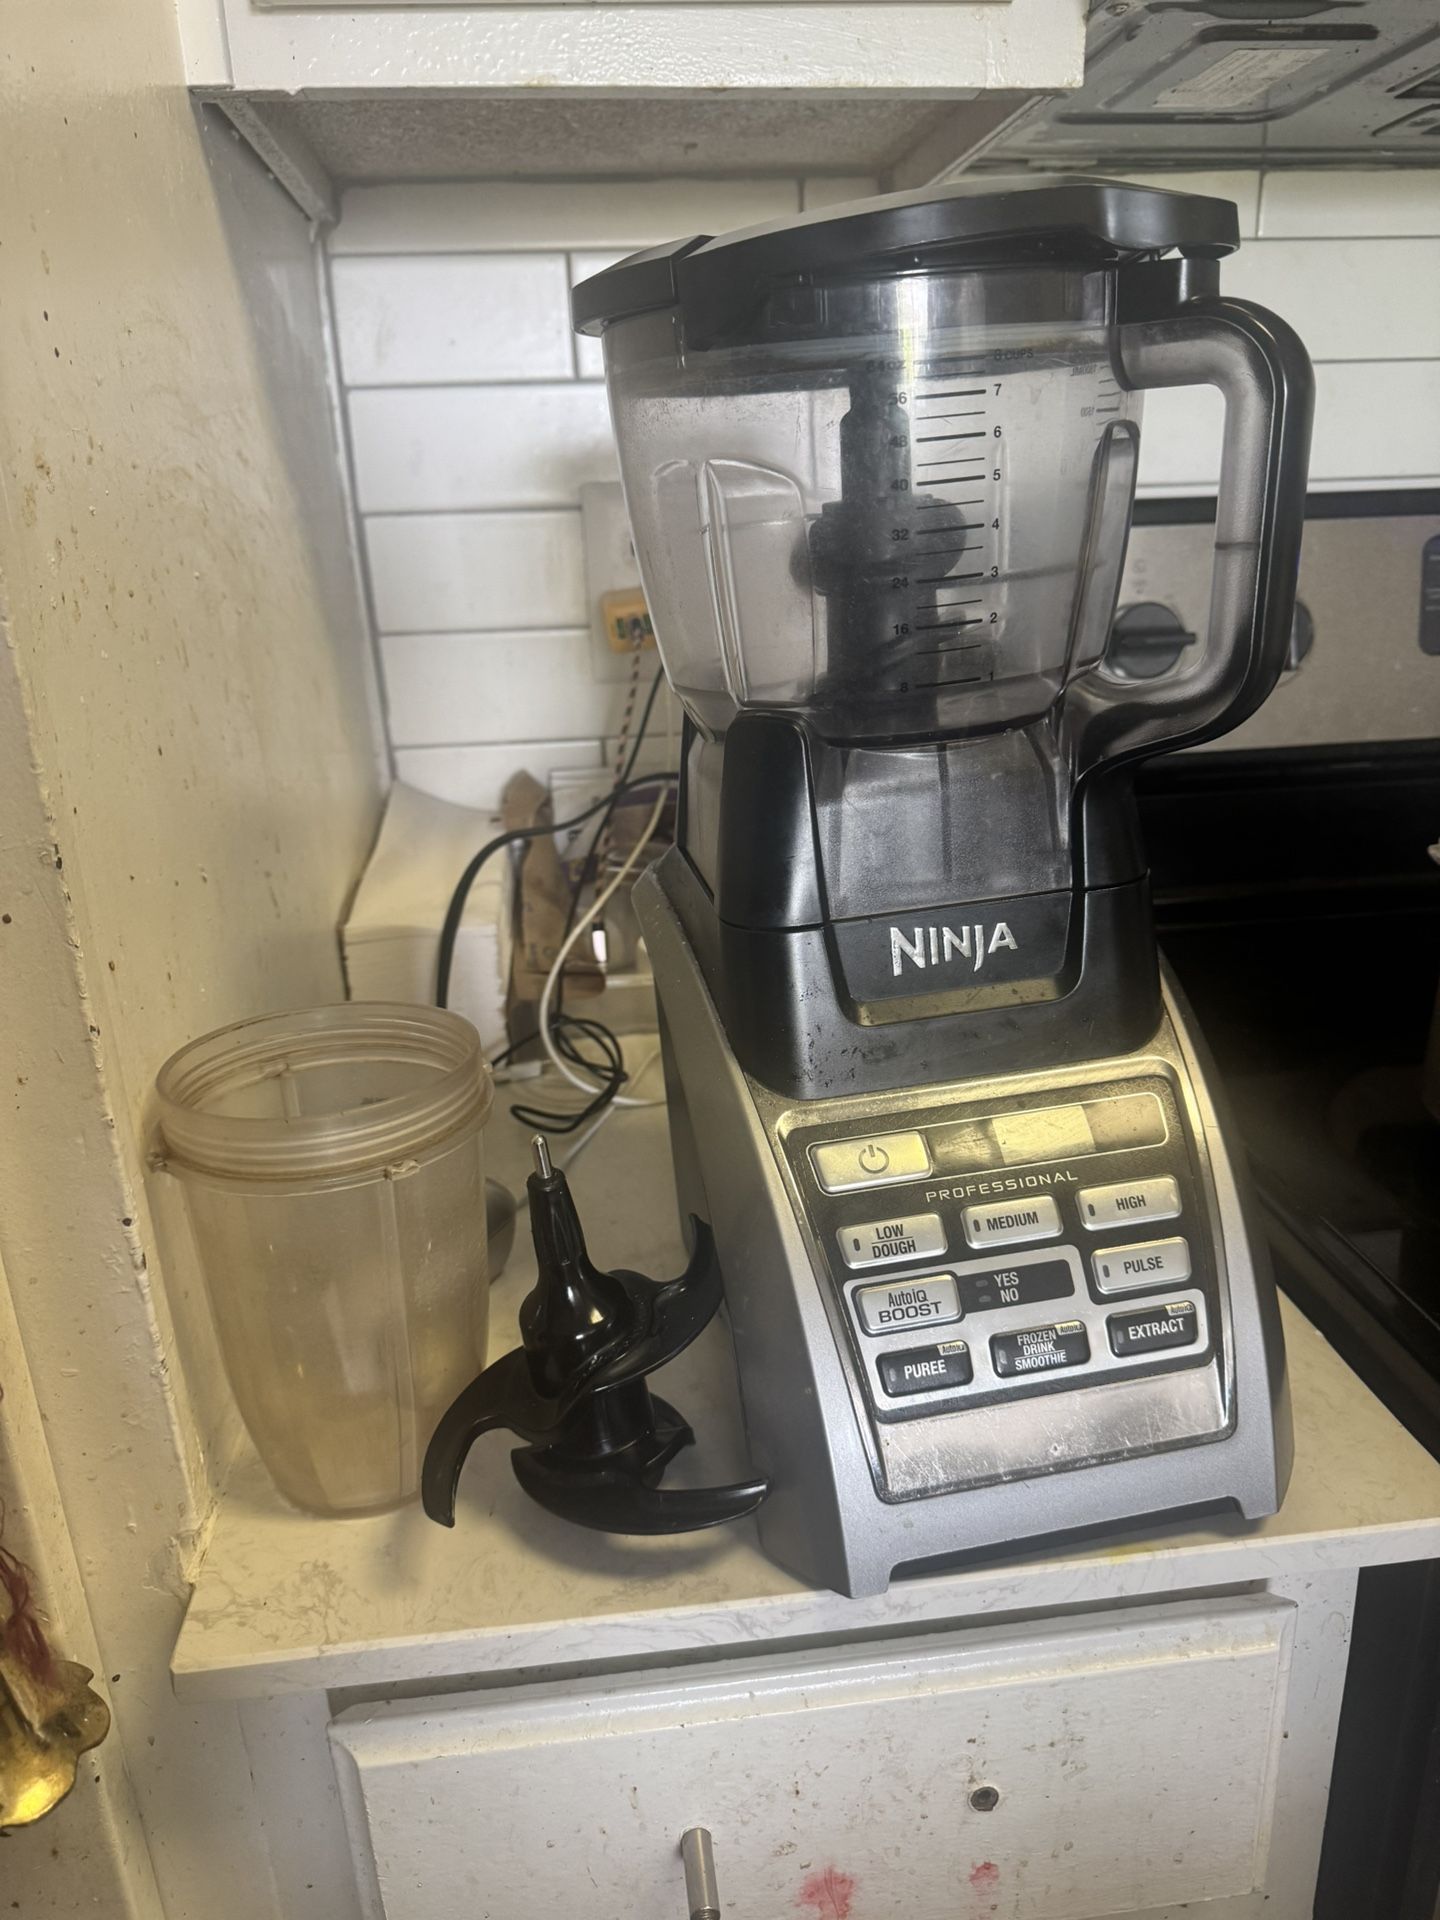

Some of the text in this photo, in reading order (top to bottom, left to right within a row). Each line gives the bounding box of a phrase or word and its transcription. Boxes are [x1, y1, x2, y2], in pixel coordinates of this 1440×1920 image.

[993, 383, 1002, 396] 7
[993, 426, 1002, 438] 6
[992, 469, 1001, 481] 5
[890, 479, 909, 491] 40
[991, 518, 1000, 530] 4
[891, 529, 909, 541] 32
[990, 566, 999, 578] 3
[892, 577, 909, 588] 24
[989, 612, 998, 624] 2
[893, 624, 909, 635] 16
[988, 671, 995, 682] 1
[890, 922, 1018, 976] NINJA
[925, 1170, 1079, 1203] PROFESSIONAL
[1116, 1194, 1147, 1211] HIGH
[986, 1211, 1039, 1231] MEDIUM
[875, 1223, 904, 1240] LOW
[872, 1240, 916, 1259] DOUGH
[1123, 1256, 1164, 1274] PULSE
[994, 1271, 1020, 1287] YES
[1000, 1287, 1019, 1303] NO
[878, 1301, 942, 1323] BOOST
[1128, 1317, 1185, 1340] EXTRACT
[1017, 1328, 1057, 1347] FROZEN
[1023, 1341, 1056, 1356] DRINK
[904, 1359, 947, 1379] PUREE
[1015, 1351, 1067, 1371] SMOOTHIE
